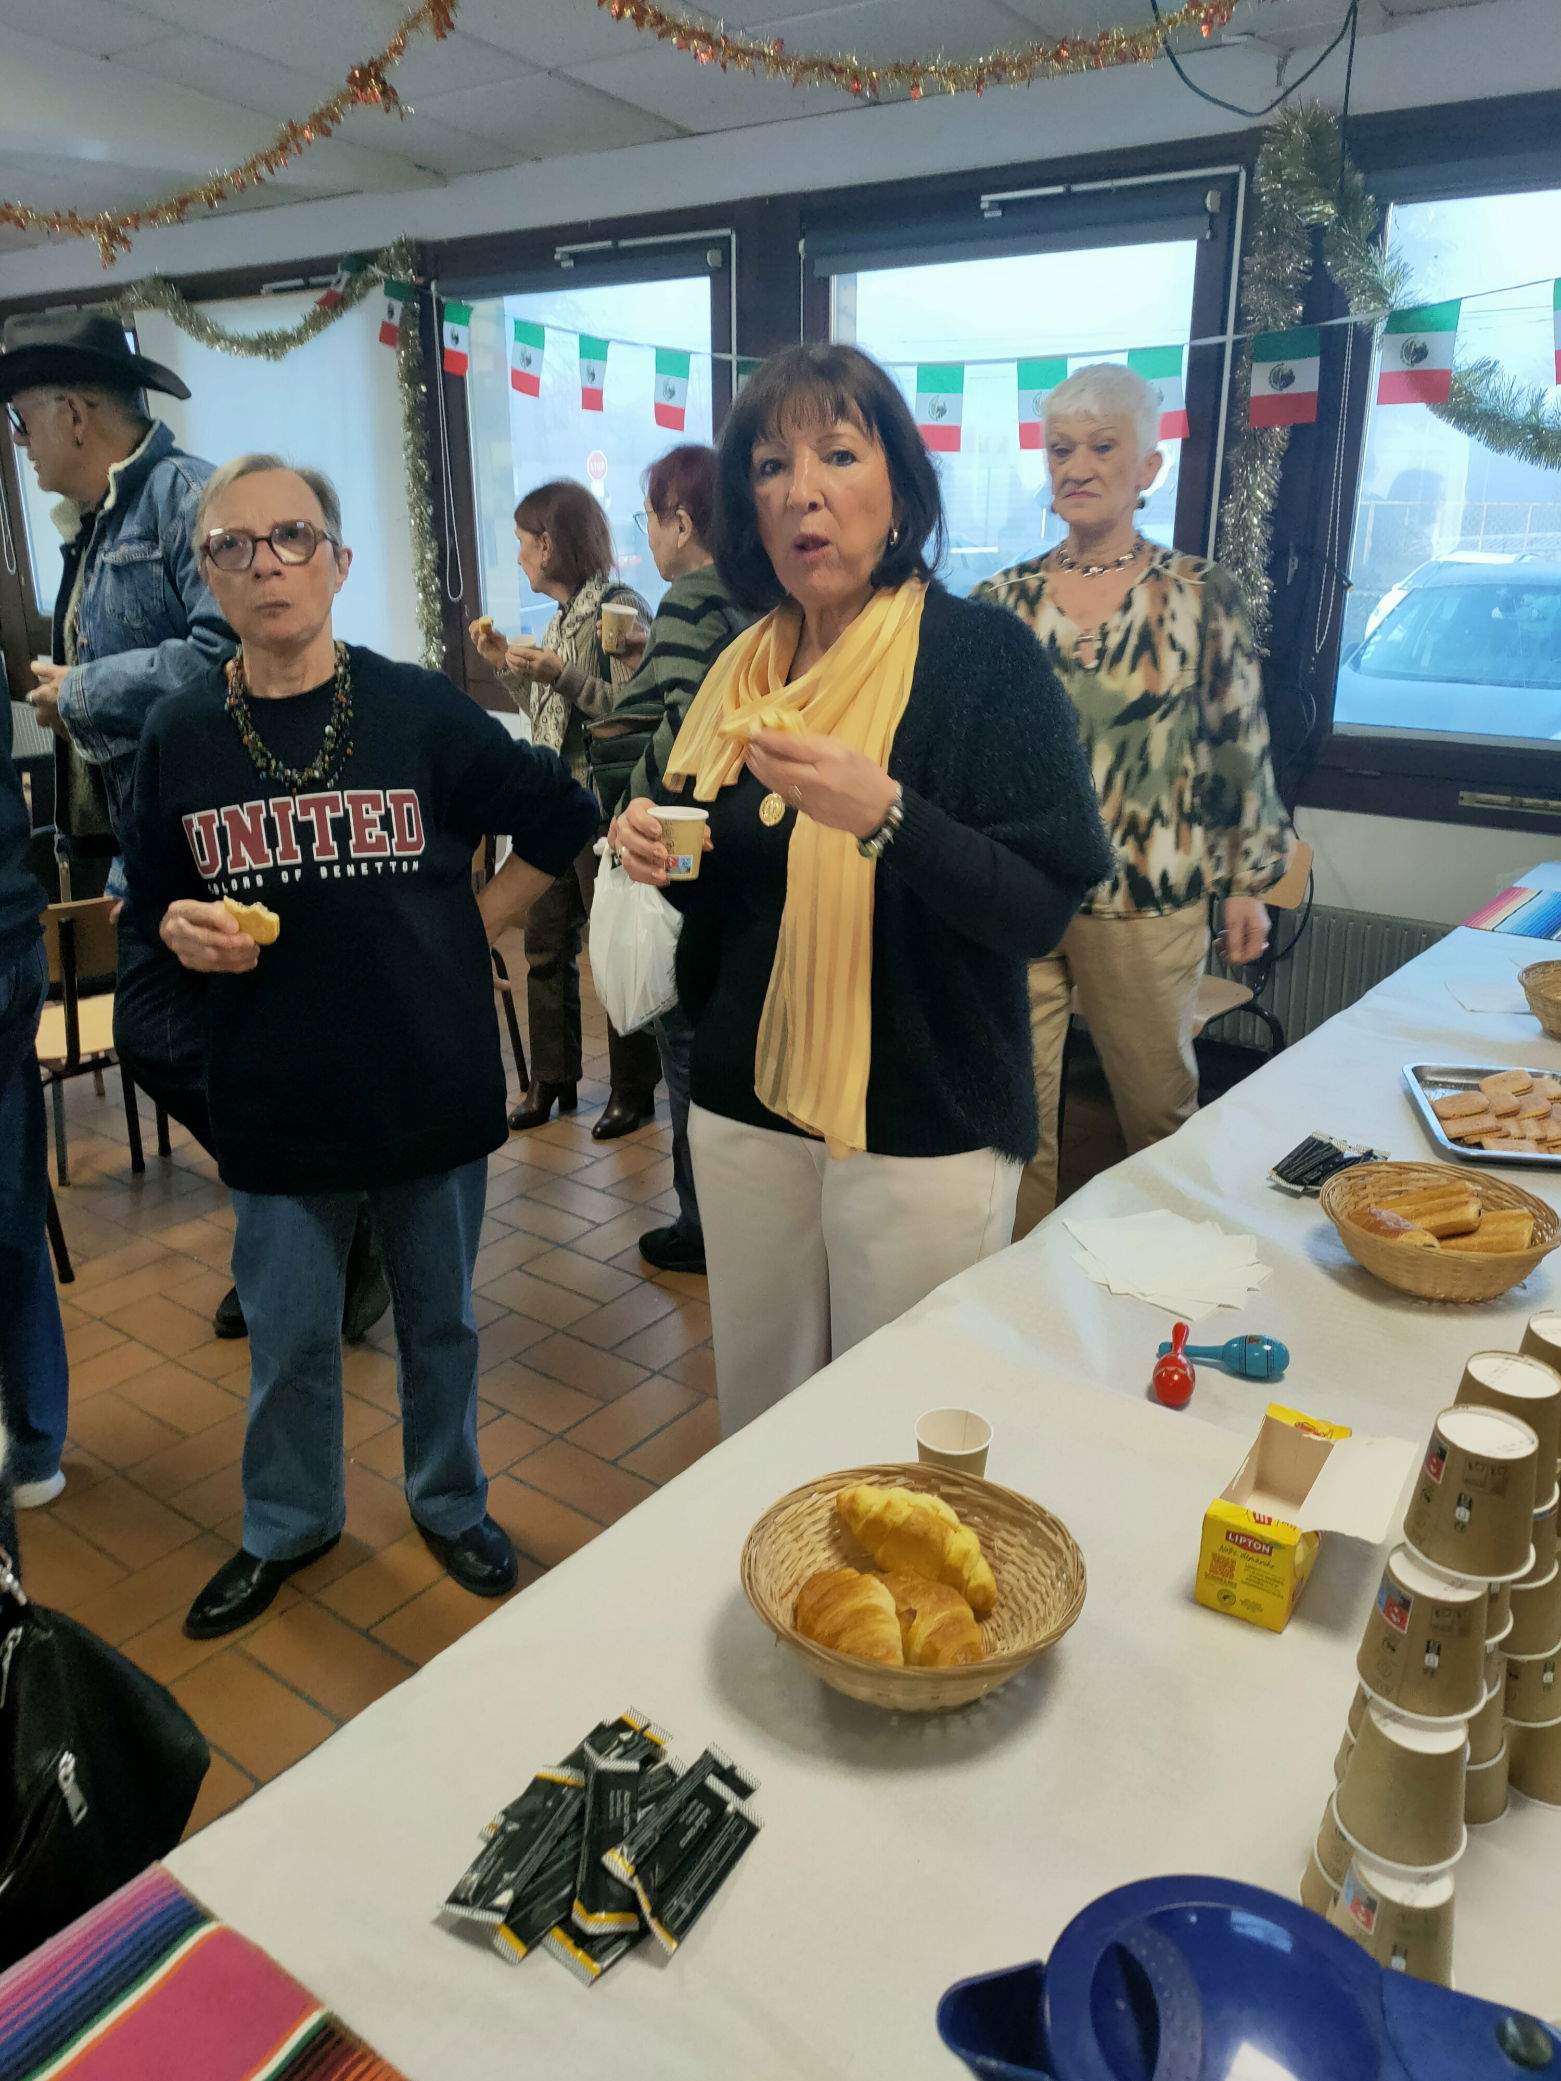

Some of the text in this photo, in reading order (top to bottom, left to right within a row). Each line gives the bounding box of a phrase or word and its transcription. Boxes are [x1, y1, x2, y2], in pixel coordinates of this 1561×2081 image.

[182, 788, 426, 880] UNITED
[281, 868, 302, 884] OF
[319, 860, 420, 880] BENETTON
[1227, 1531, 1271, 1554] LIPTON
